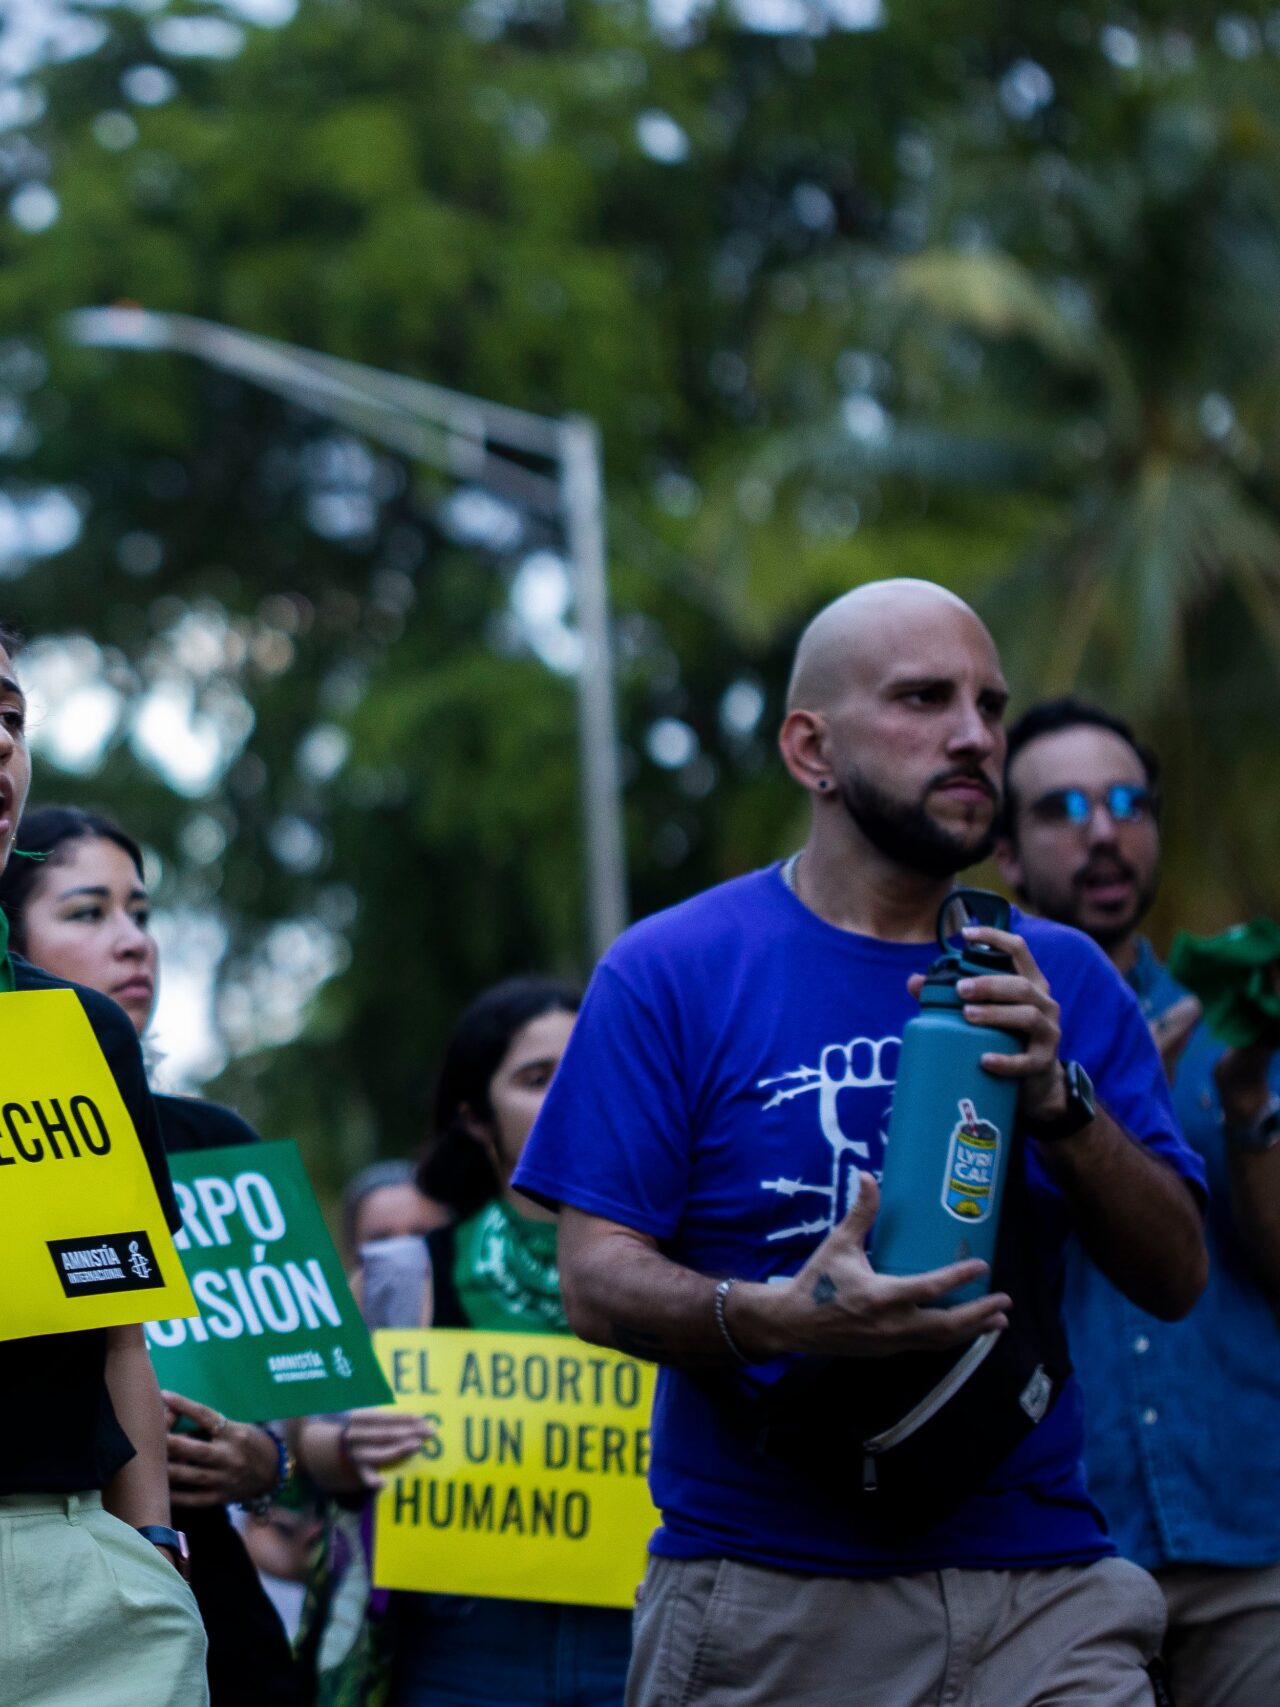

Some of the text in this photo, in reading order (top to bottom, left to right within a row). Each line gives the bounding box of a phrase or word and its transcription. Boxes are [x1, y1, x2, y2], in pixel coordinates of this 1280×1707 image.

[954, 1162, 991, 1183] CAL
[61, 1244, 121, 1270] AMNISTÍA
[391, 1348, 642, 1410] EL ABORTO
[418, 1410, 445, 1461] S
[463, 1415, 525, 1467] UN
[393, 1476, 592, 1541] HUMANO
